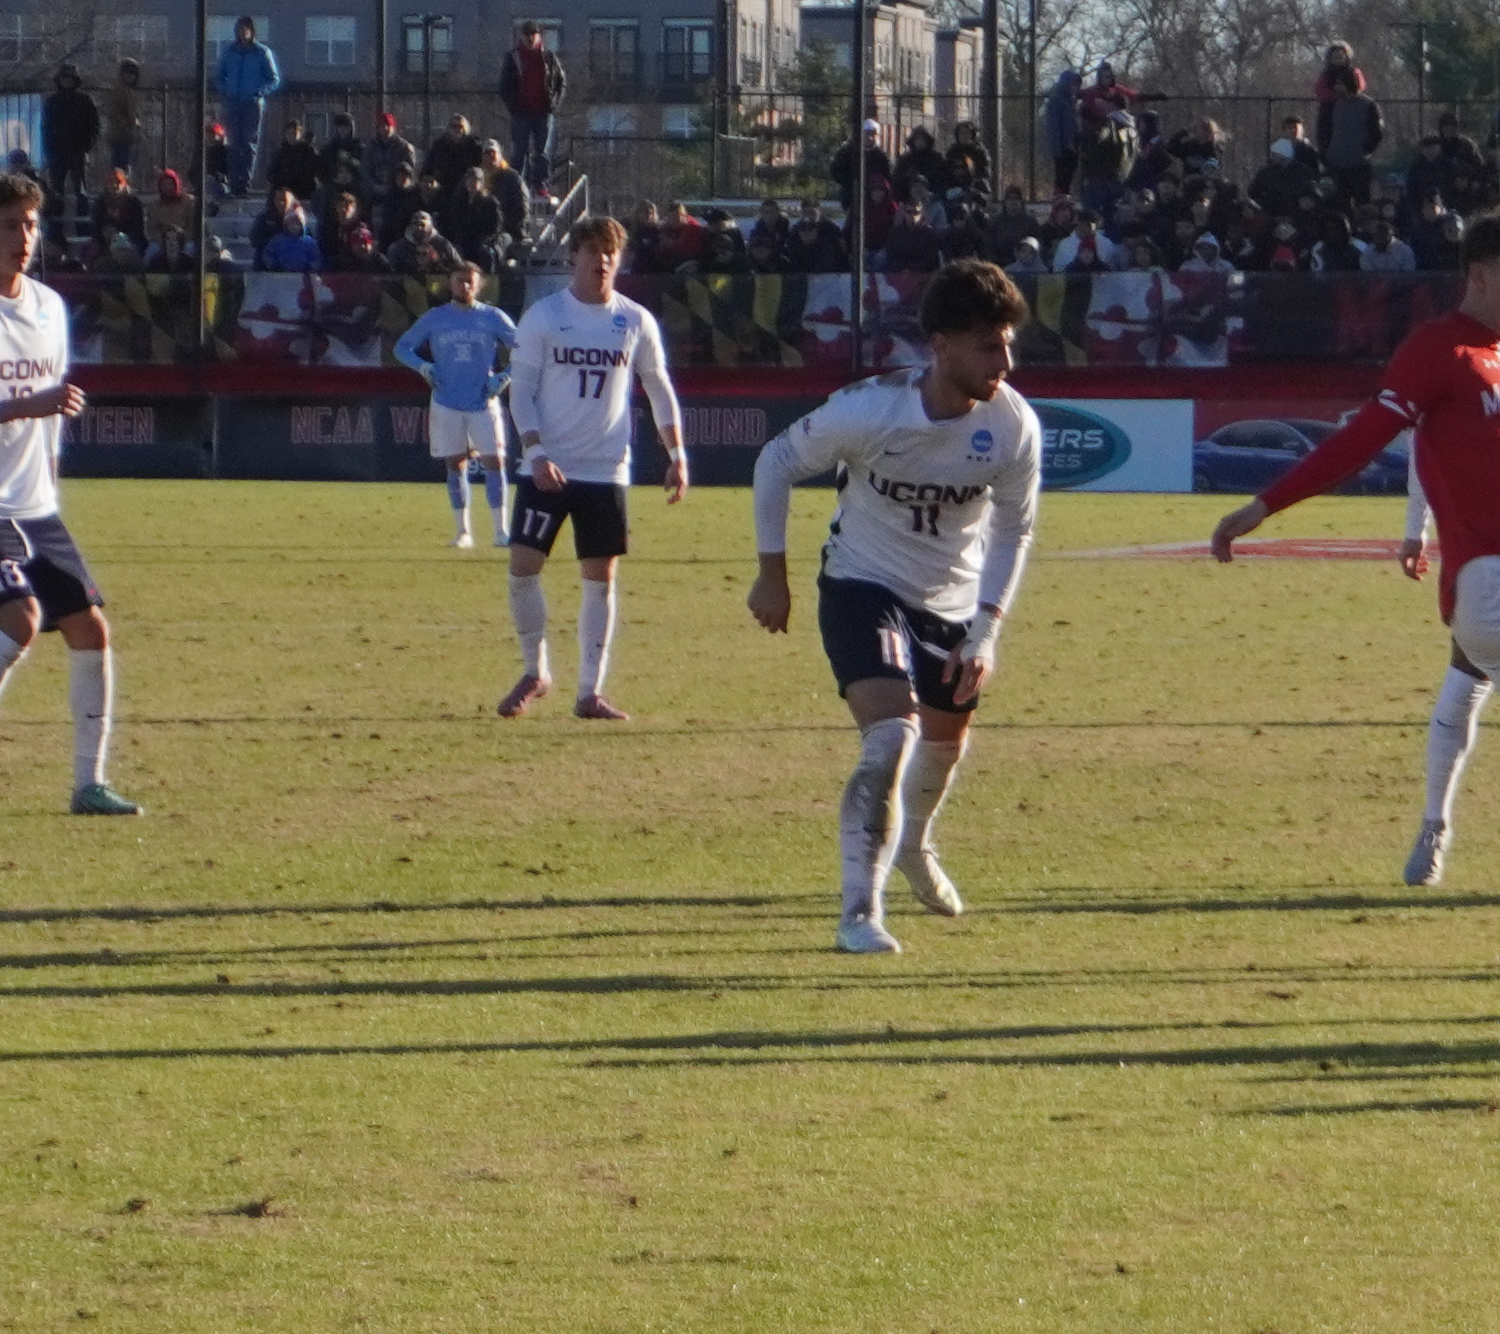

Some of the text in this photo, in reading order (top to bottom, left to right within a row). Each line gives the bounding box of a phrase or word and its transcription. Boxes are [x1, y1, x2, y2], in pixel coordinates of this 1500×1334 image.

[553, 346, 630, 368] UCONN
[578, 369, 608, 399] 17
[62, 406, 155, 445] TEEN
[291, 406, 374, 444] NCAA
[680, 407, 767, 447] OUND
[1042, 428, 1105, 449] ERS
[1042, 453, 1082, 468] CES
[867, 469, 994, 505] UCONN
[522, 508, 552, 539] 17
[910, 504, 942, 536] 11
